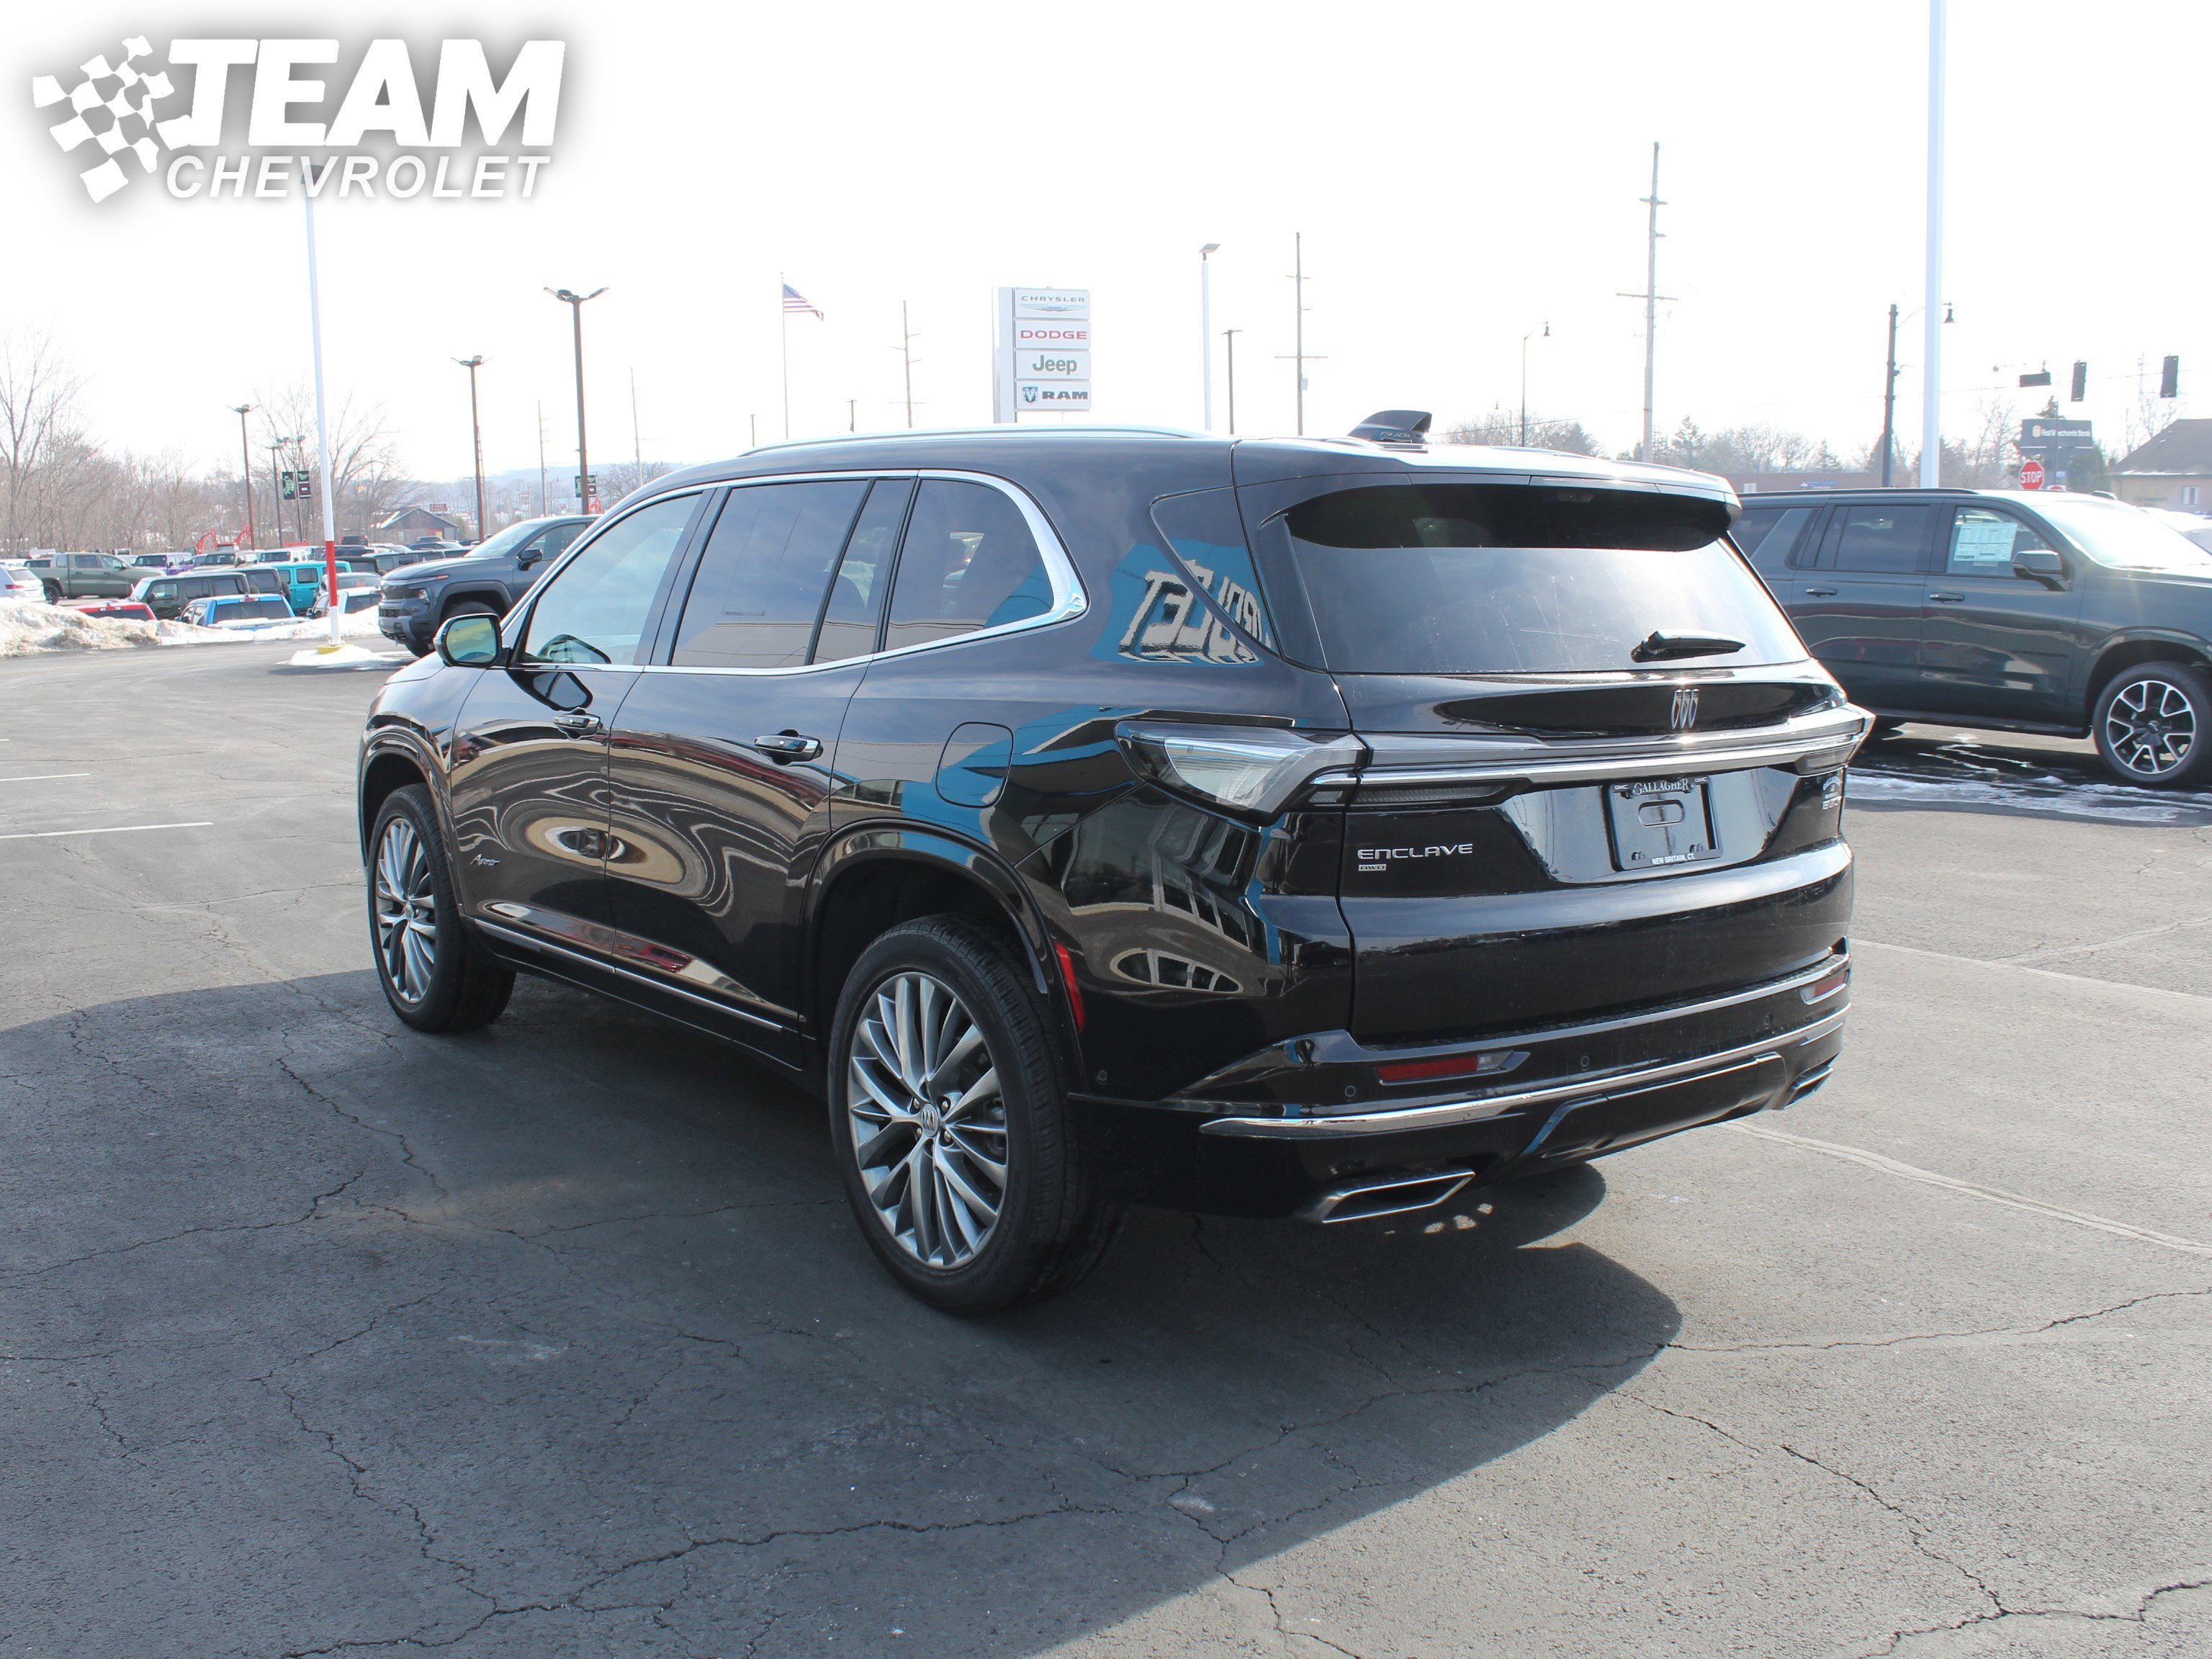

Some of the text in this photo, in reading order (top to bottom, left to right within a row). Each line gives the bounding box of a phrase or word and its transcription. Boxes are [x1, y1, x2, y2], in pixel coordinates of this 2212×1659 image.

[1020, 330, 1087, 340] DODGE
[1032, 355, 1078, 375] Jeep
[1042, 391, 1089, 400] RAM
[2020, 470, 2042, 484] STOP
[1632, 778, 1689, 796] GALLAGHER
[1357, 843, 1473, 860] ENCLAVE
[1651, 857, 1664, 866] NEW
